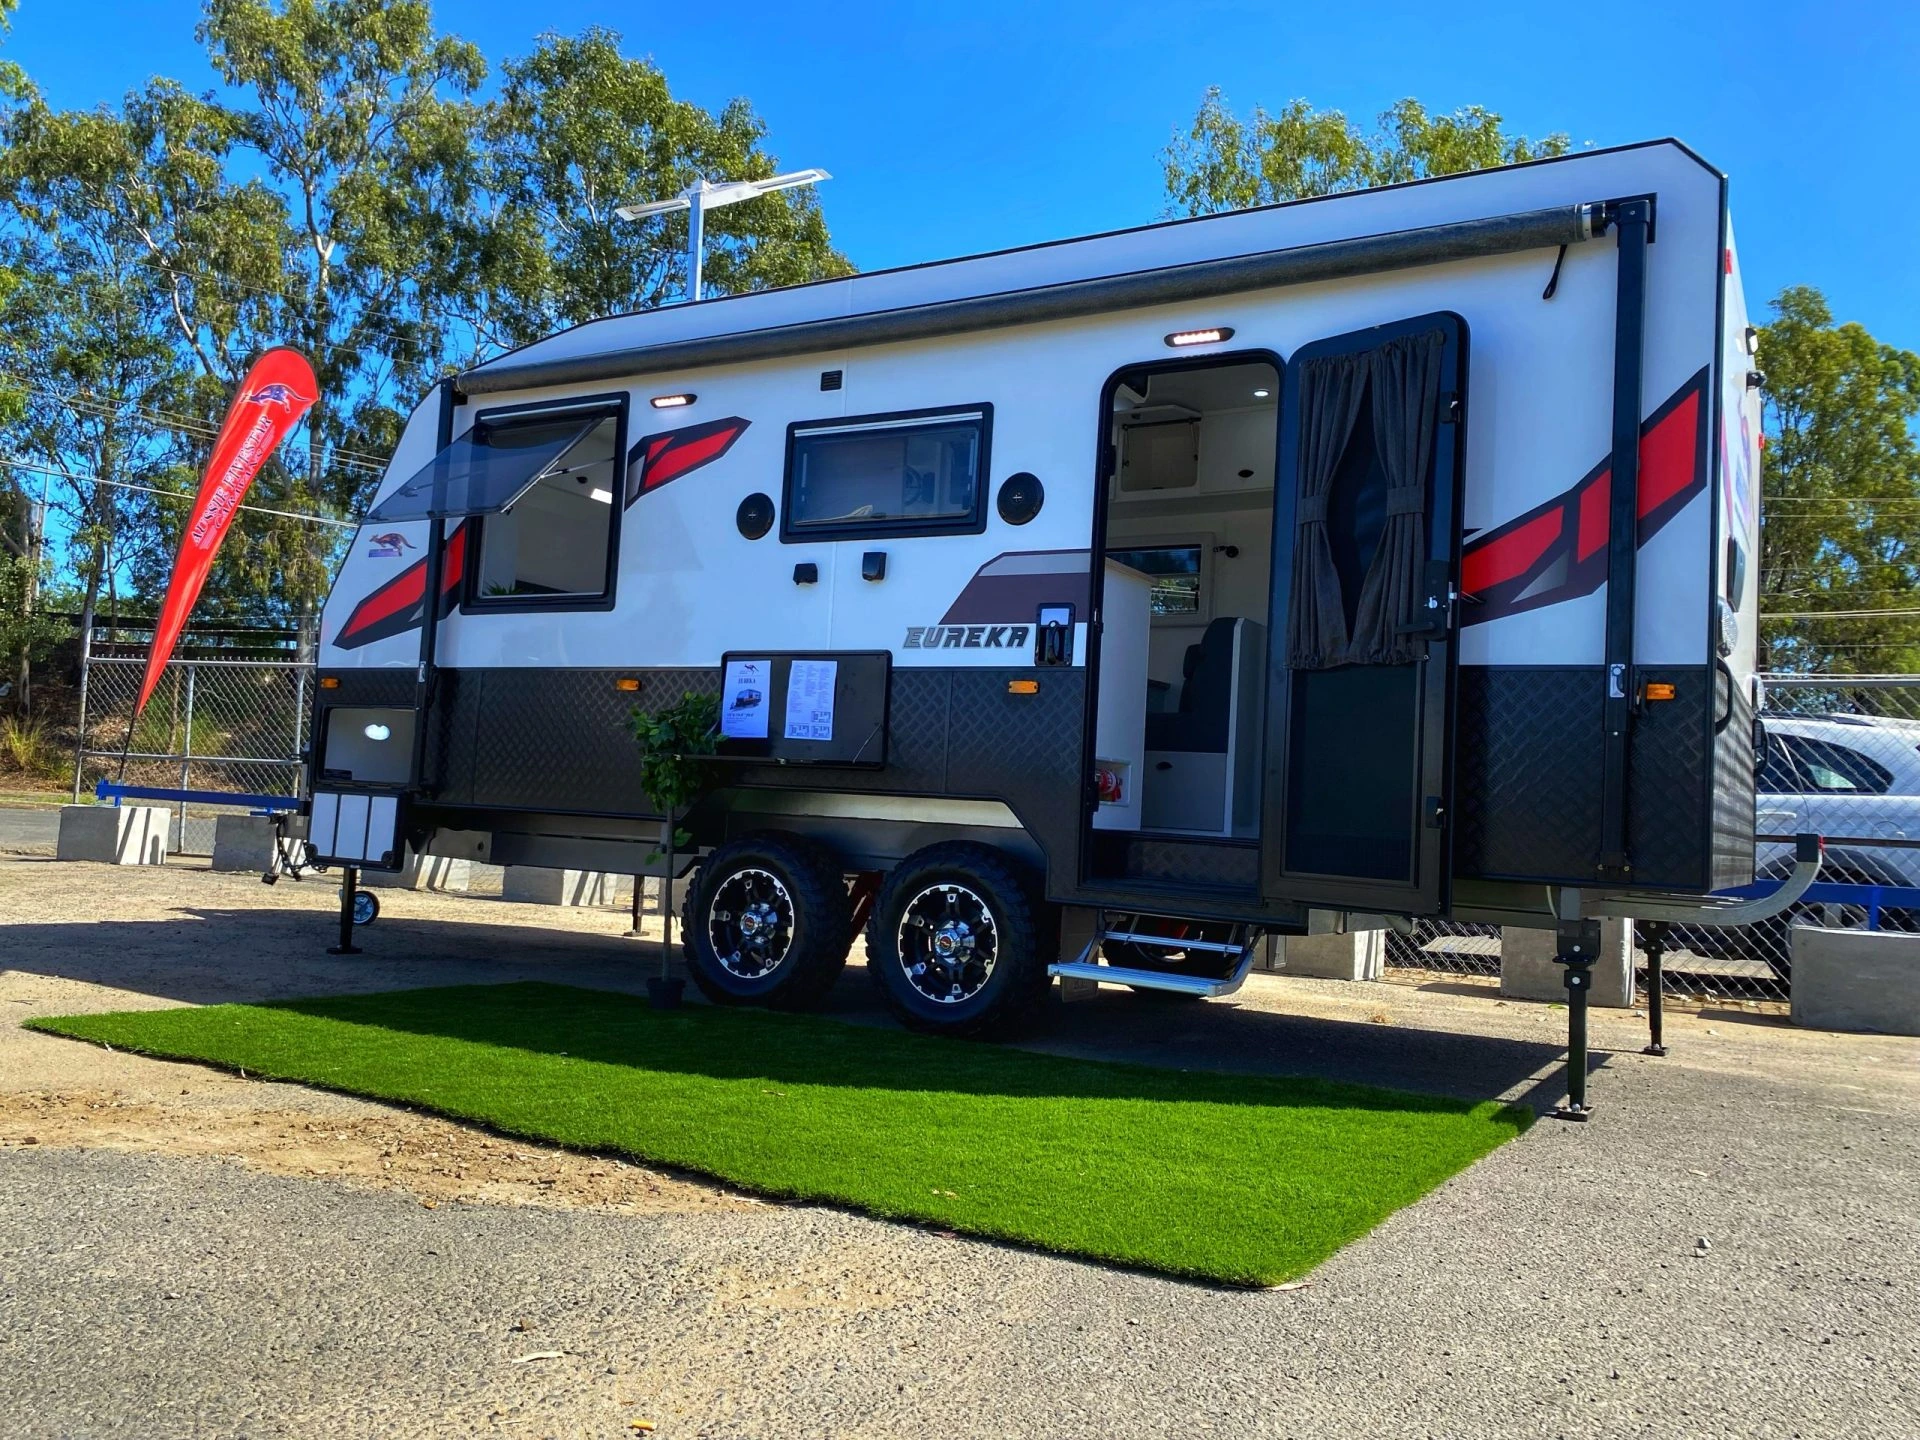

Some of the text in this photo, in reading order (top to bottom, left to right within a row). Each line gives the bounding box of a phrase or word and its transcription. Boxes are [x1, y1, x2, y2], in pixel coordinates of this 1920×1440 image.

[192, 415, 272, 543] AUSSIE FIVESTAR
[903, 626, 1029, 649] EUREKA
